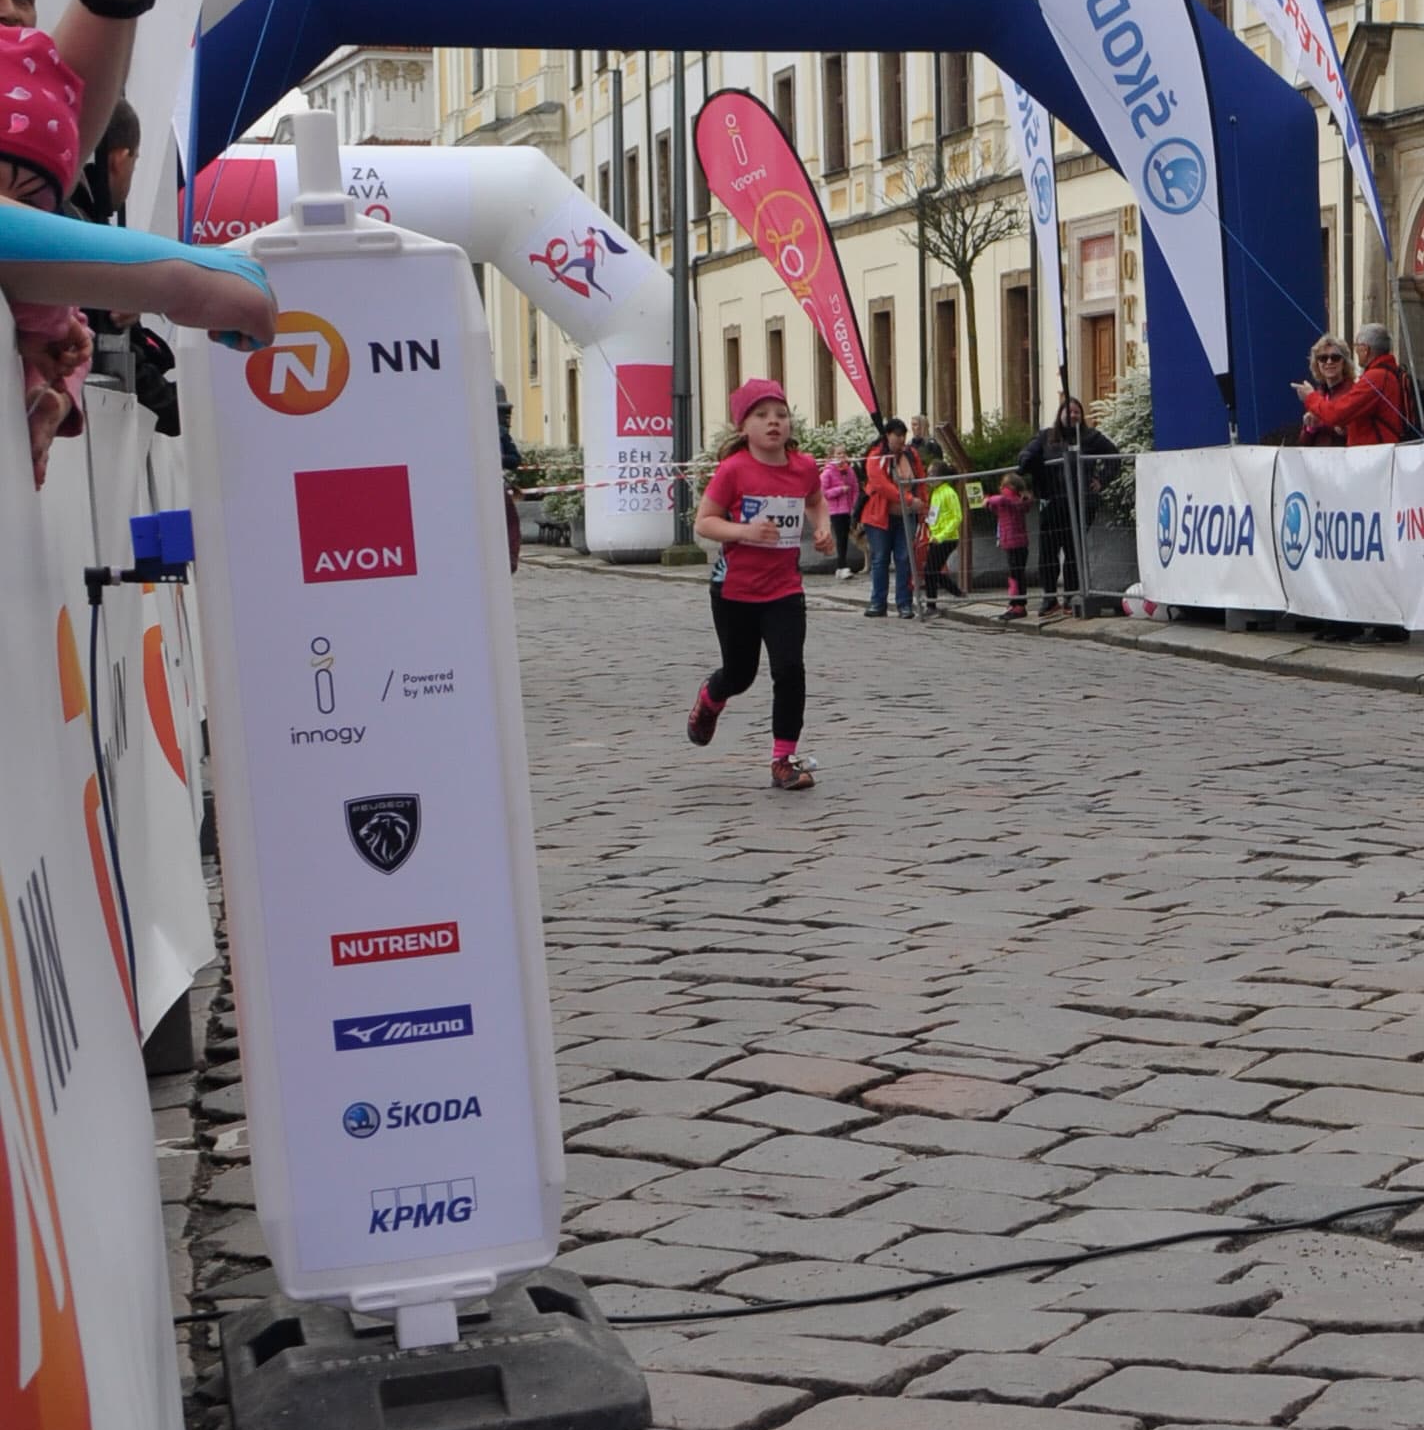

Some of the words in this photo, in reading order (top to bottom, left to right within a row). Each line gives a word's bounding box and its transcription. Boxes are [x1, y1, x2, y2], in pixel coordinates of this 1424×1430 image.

[352, 168, 379, 180] ZA
[347, 182, 389, 199] AVÁ
[368, 339, 440, 373] NN
[660, 451, 674, 463] Z
[618, 467, 675, 479] ZDRAV
[617, 498, 663, 512] 2023
[1179, 494, 1255, 556] ŠKODA
[1314, 500, 1385, 562] ŠKODA
[314, 547, 403, 573] AVON
[403, 669, 454, 683] Powered
[403, 687, 418, 699] by
[423, 684, 454, 696] MVM
[290, 726, 366, 745] innogy
[351, 800, 413, 812] PEUGEOT
[338, 929, 453, 959] NUTREND
[386, 1096, 482, 1129] ŠKODA
[369, 1196, 473, 1235] KPMG
